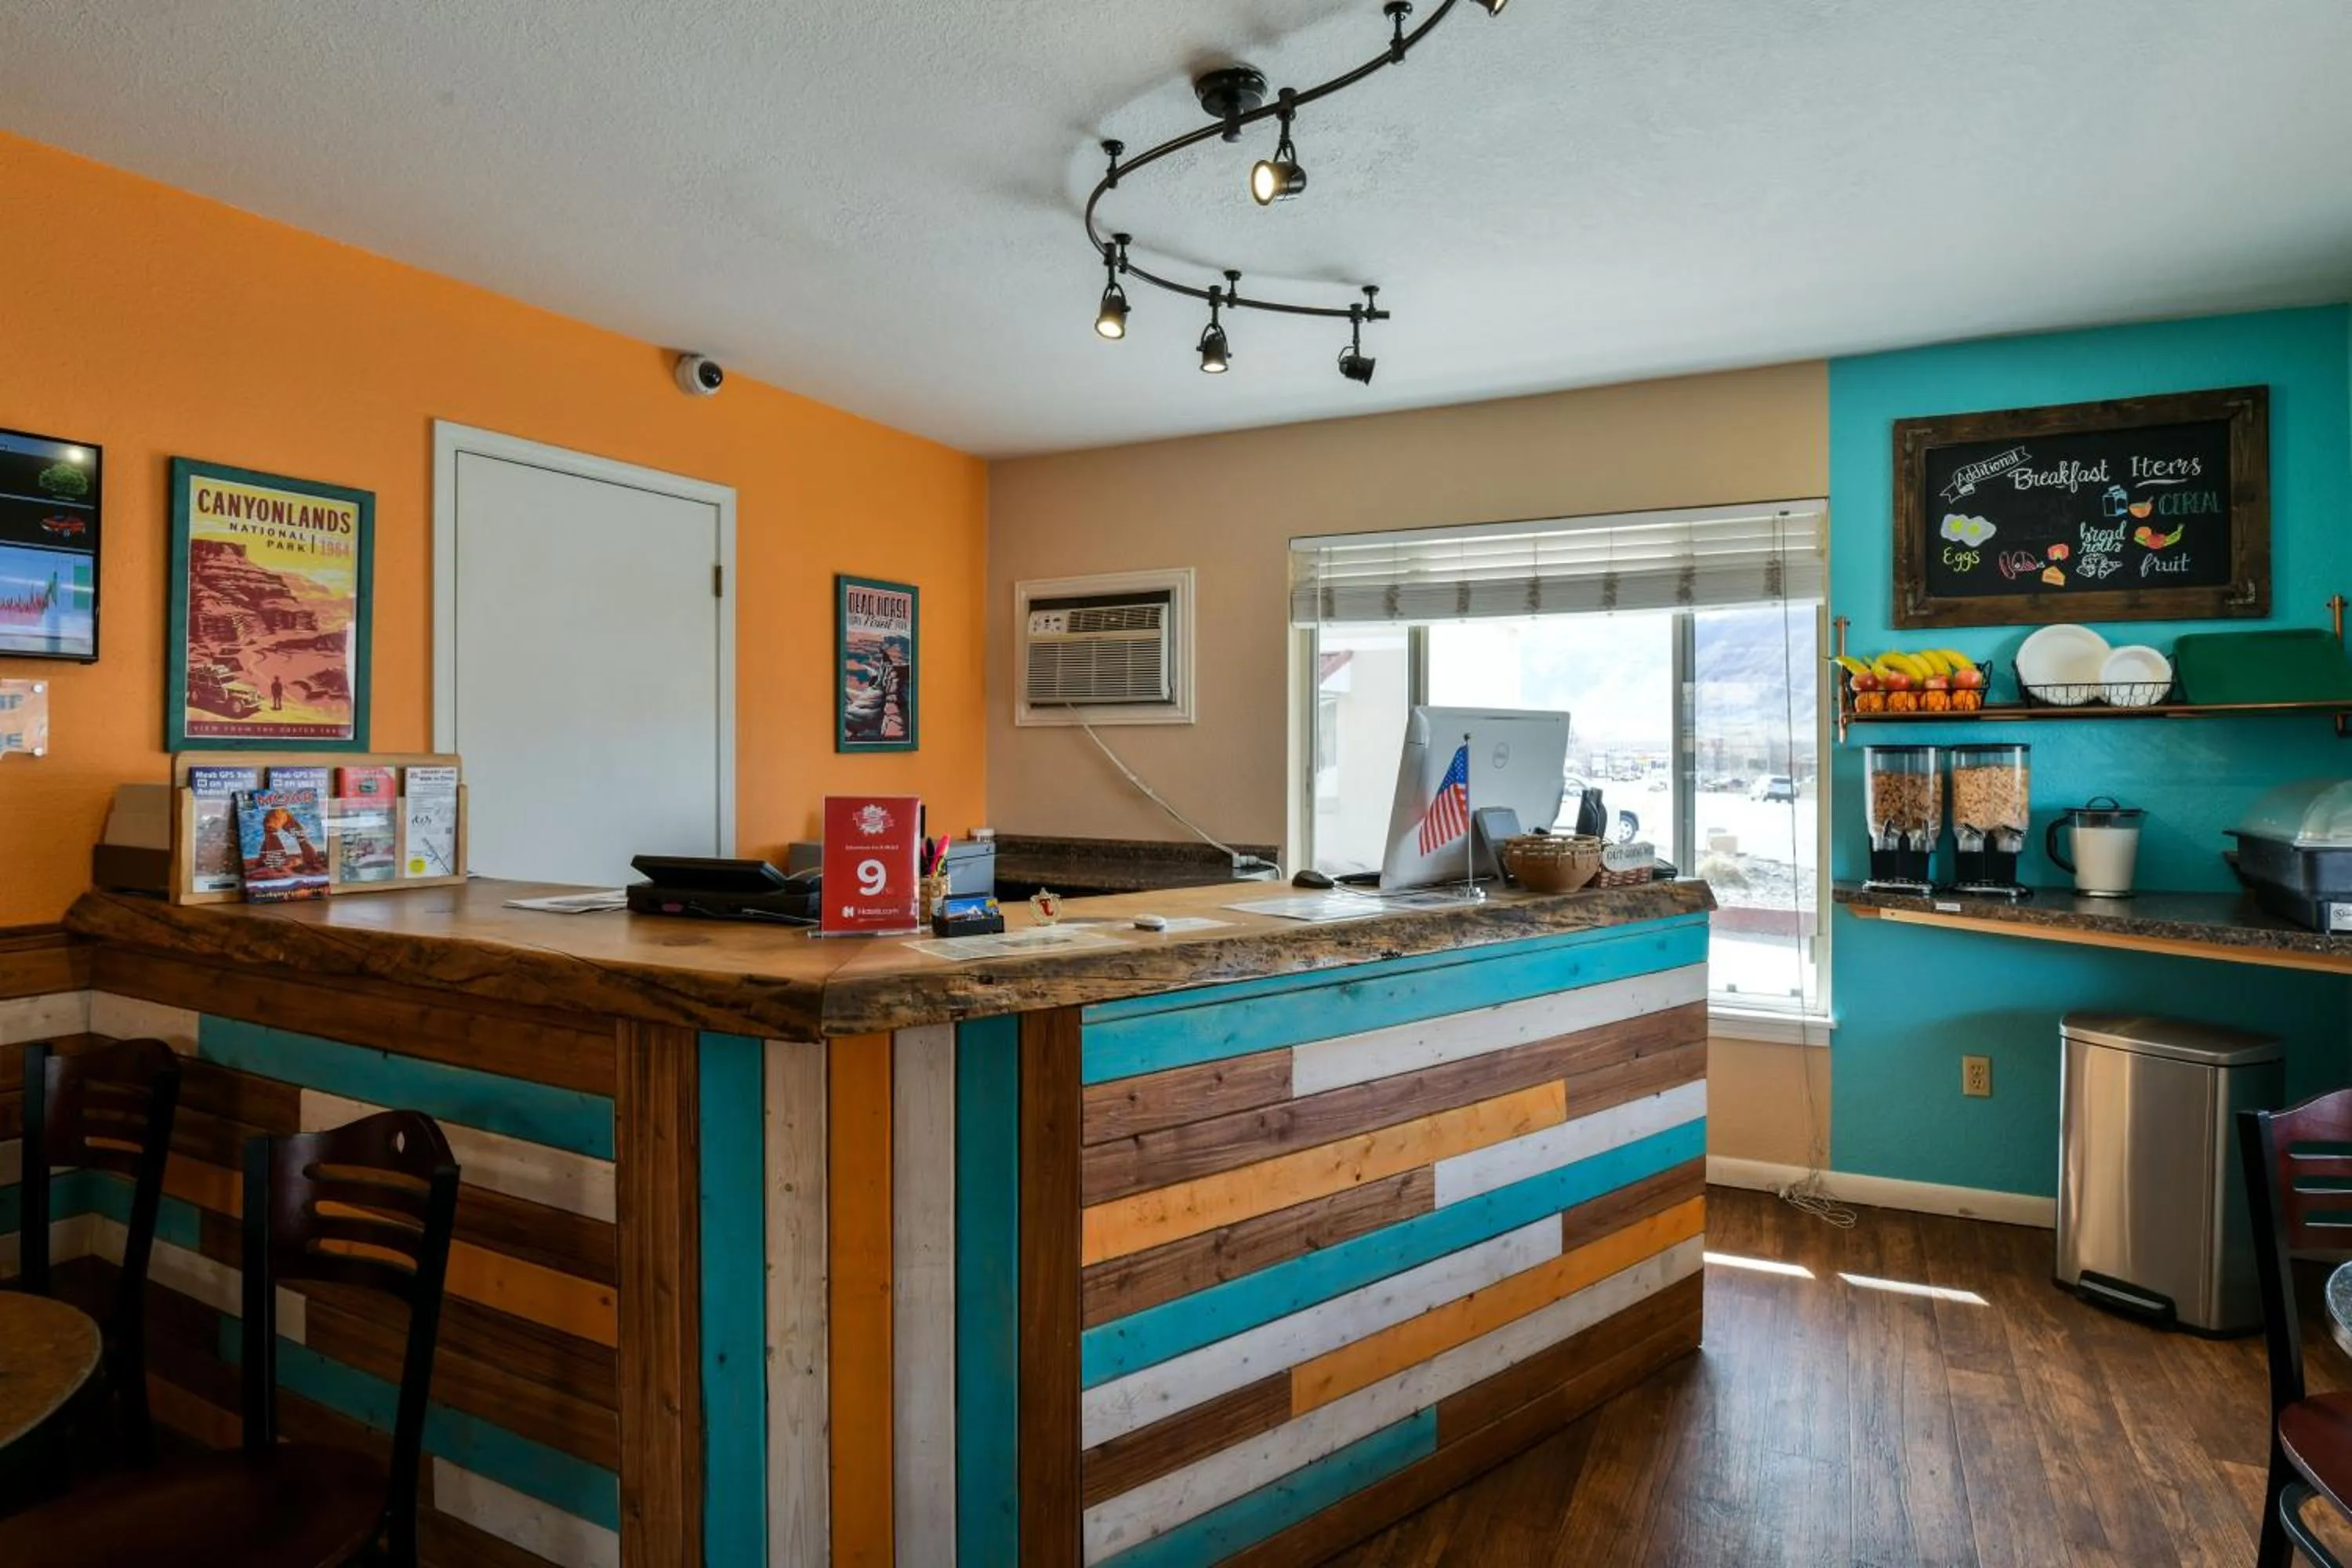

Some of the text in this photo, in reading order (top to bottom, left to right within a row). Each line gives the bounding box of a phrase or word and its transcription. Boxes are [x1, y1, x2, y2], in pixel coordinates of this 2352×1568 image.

[1957, 450, 2202, 493] Additional Breakfast Items
[198, 488, 351, 534] CANYONLANDS
[2158, 491, 2223, 516] CEREAL
[229, 522, 307, 541] NATIONAL
[2079, 520, 2127, 543] bread
[267, 539, 306, 553] PARK
[2078, 539, 2124, 554] rolls
[1944, 546, 1980, 572] Eggs
[2140, 552, 2191, 578] fruit
[848, 592, 874, 615] DEAD
[857, 858, 887, 896] 9
